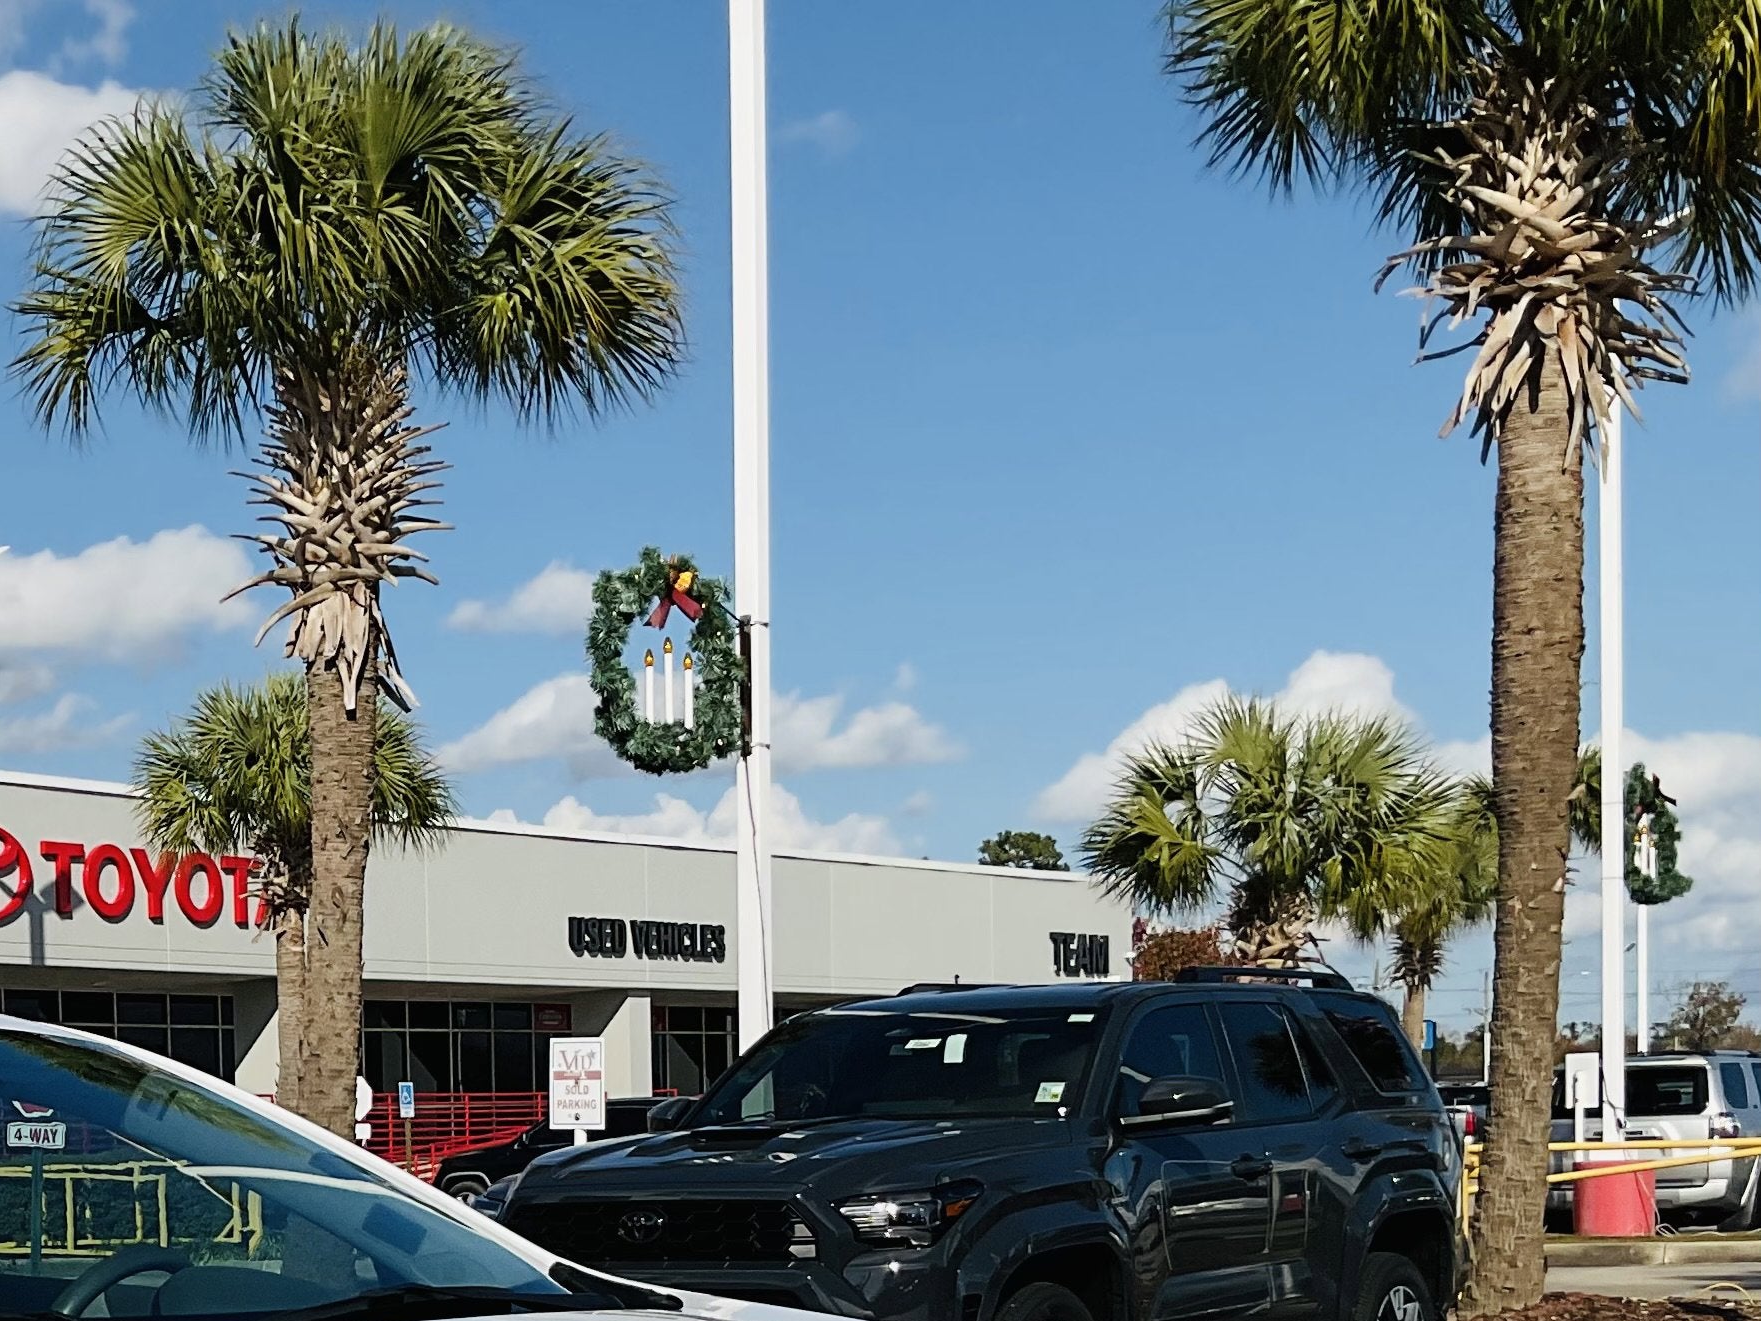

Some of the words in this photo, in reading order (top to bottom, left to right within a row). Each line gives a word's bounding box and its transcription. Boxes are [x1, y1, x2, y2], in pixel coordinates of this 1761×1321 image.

[40, 840, 273, 930] TOYOT
[568, 917, 627, 958] USED
[629, 920, 726, 963] VEHICLES
[1049, 932, 1110, 978] TEAM
[557, 1099, 597, 1110] PARKING
[565, 1085, 589, 1095] SOLD
[14, 1127, 58, 1144] 4-WAY
